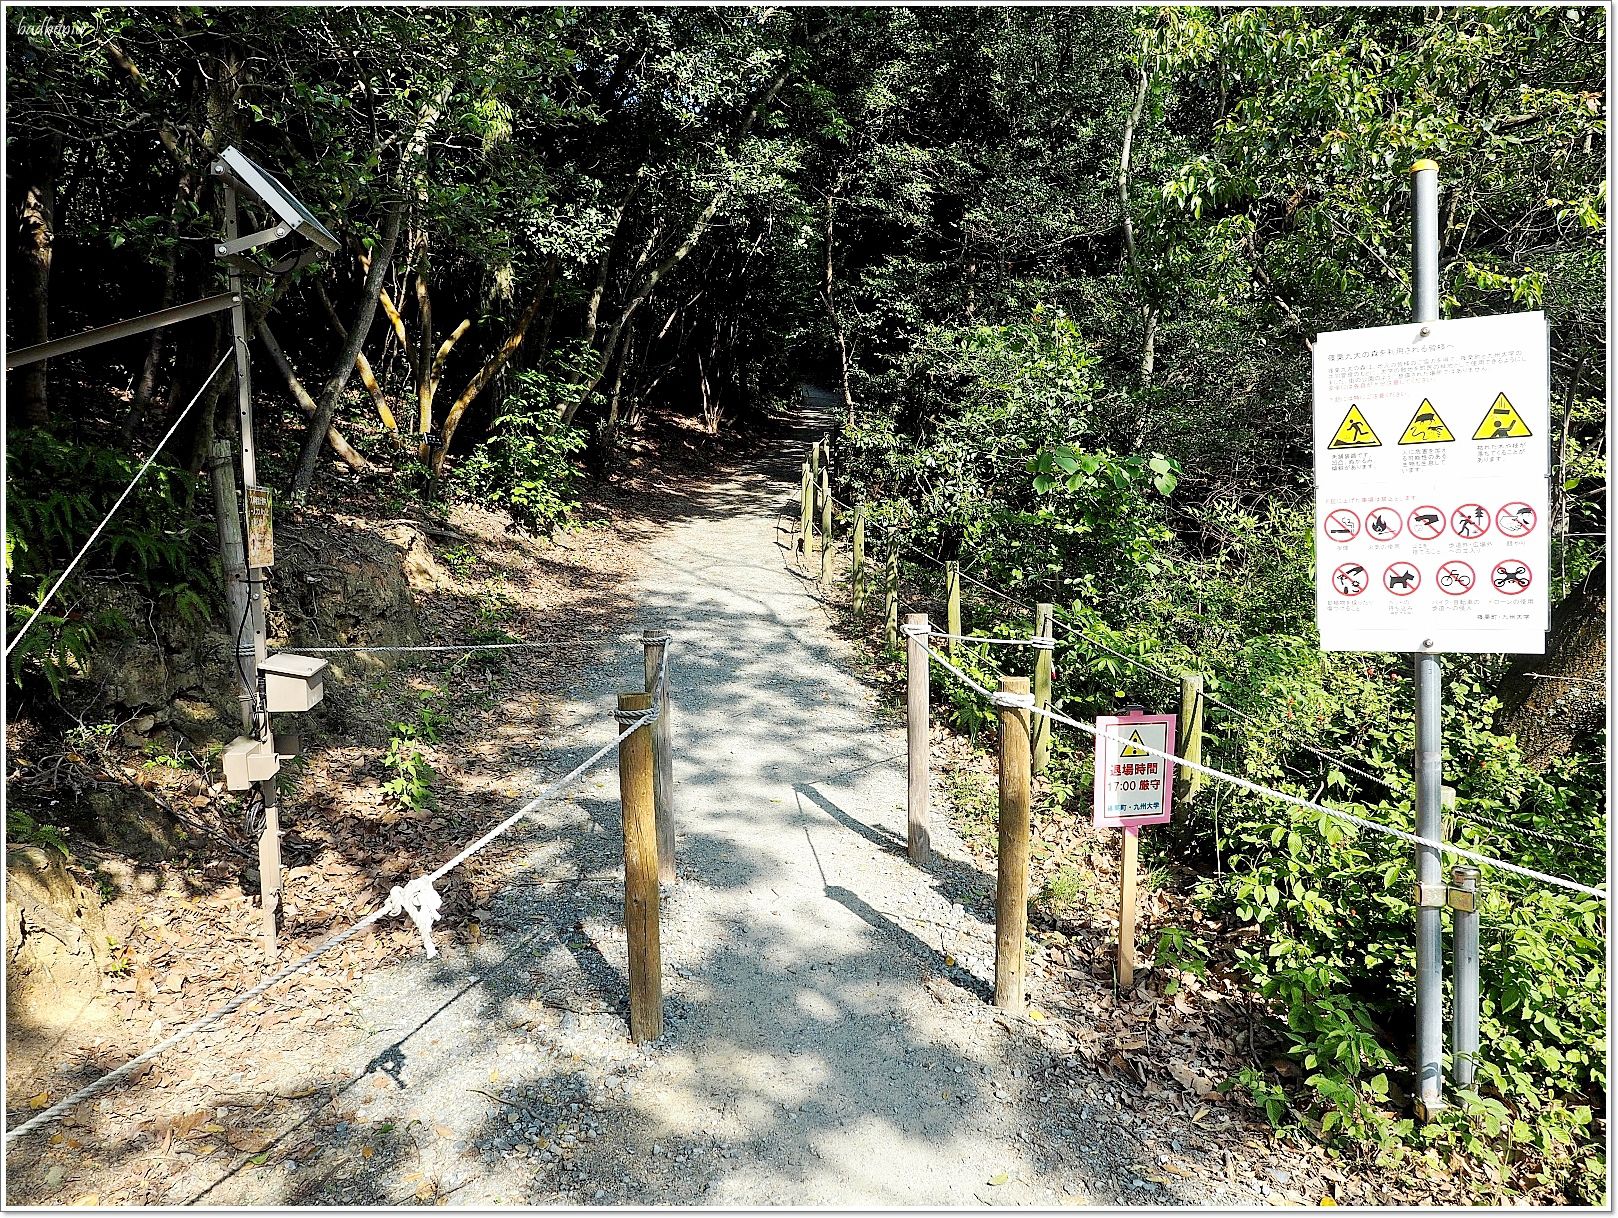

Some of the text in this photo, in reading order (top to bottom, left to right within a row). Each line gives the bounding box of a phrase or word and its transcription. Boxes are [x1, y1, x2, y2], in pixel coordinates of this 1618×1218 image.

[1110, 762, 1158, 777] 退場時間
[1108, 779, 1161, 791] 17:00 厳守
